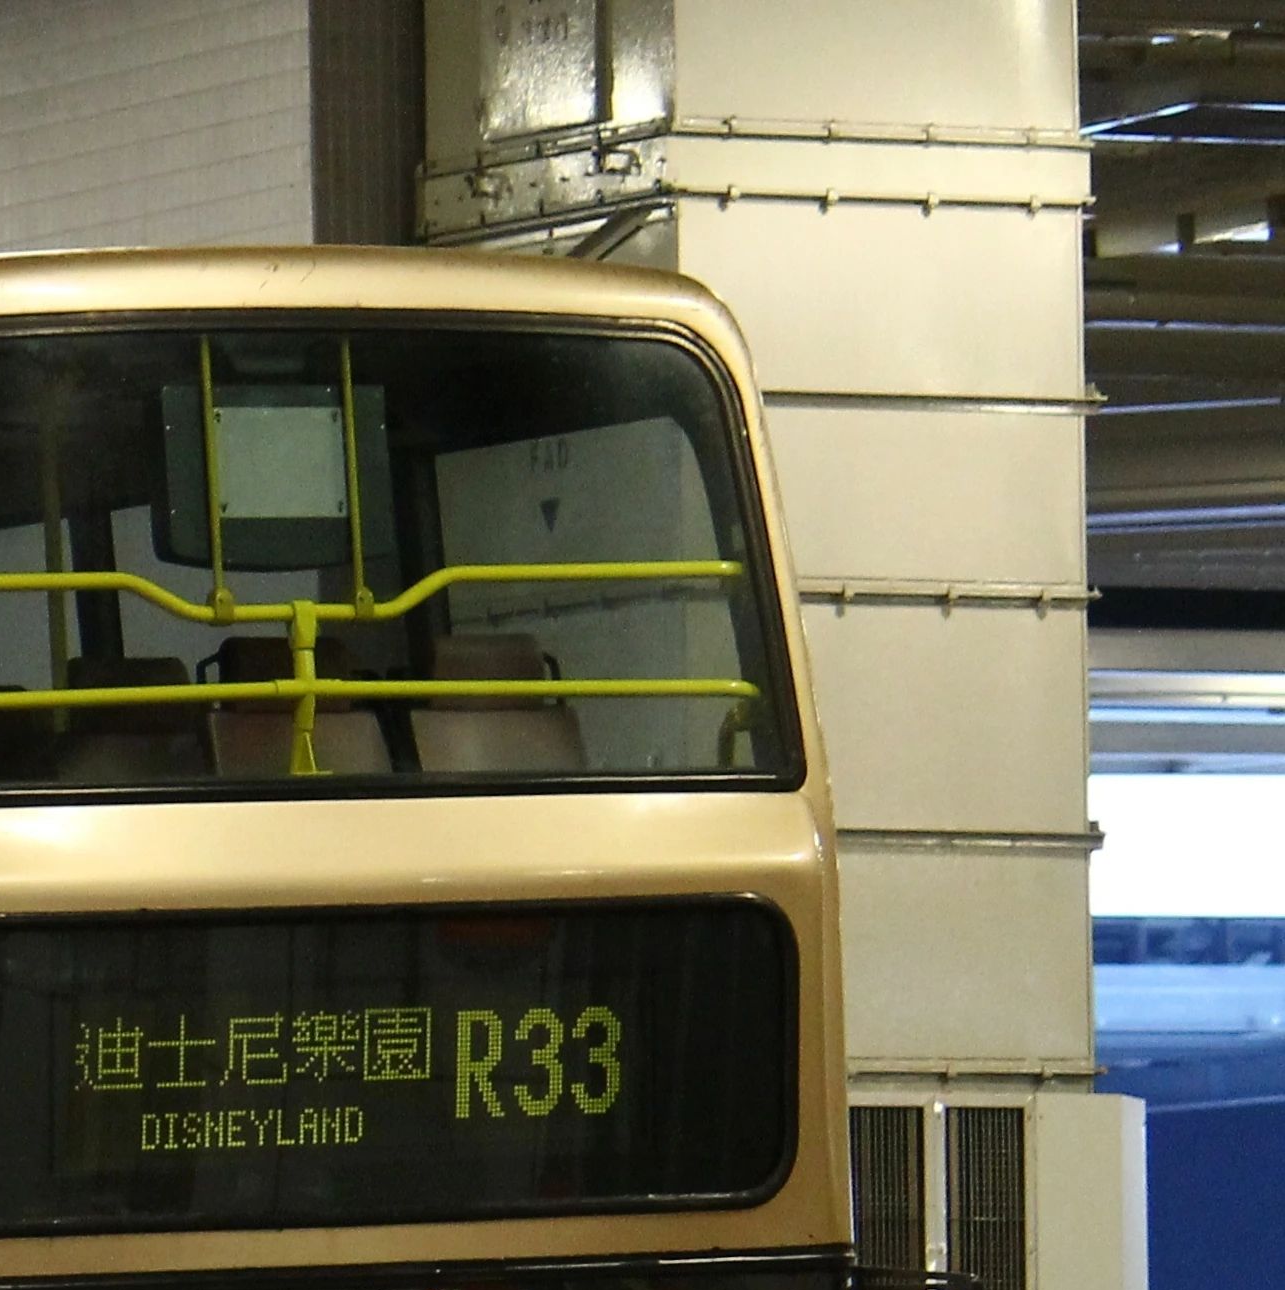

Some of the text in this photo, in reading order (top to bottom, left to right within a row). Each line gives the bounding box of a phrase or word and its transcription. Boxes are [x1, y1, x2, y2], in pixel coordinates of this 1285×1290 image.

[74, 1006, 431, 1092] 迪士尼樂園
[454, 1005, 622, 1119] R33
[140, 1105, 364, 1151] DISNEYLAND
